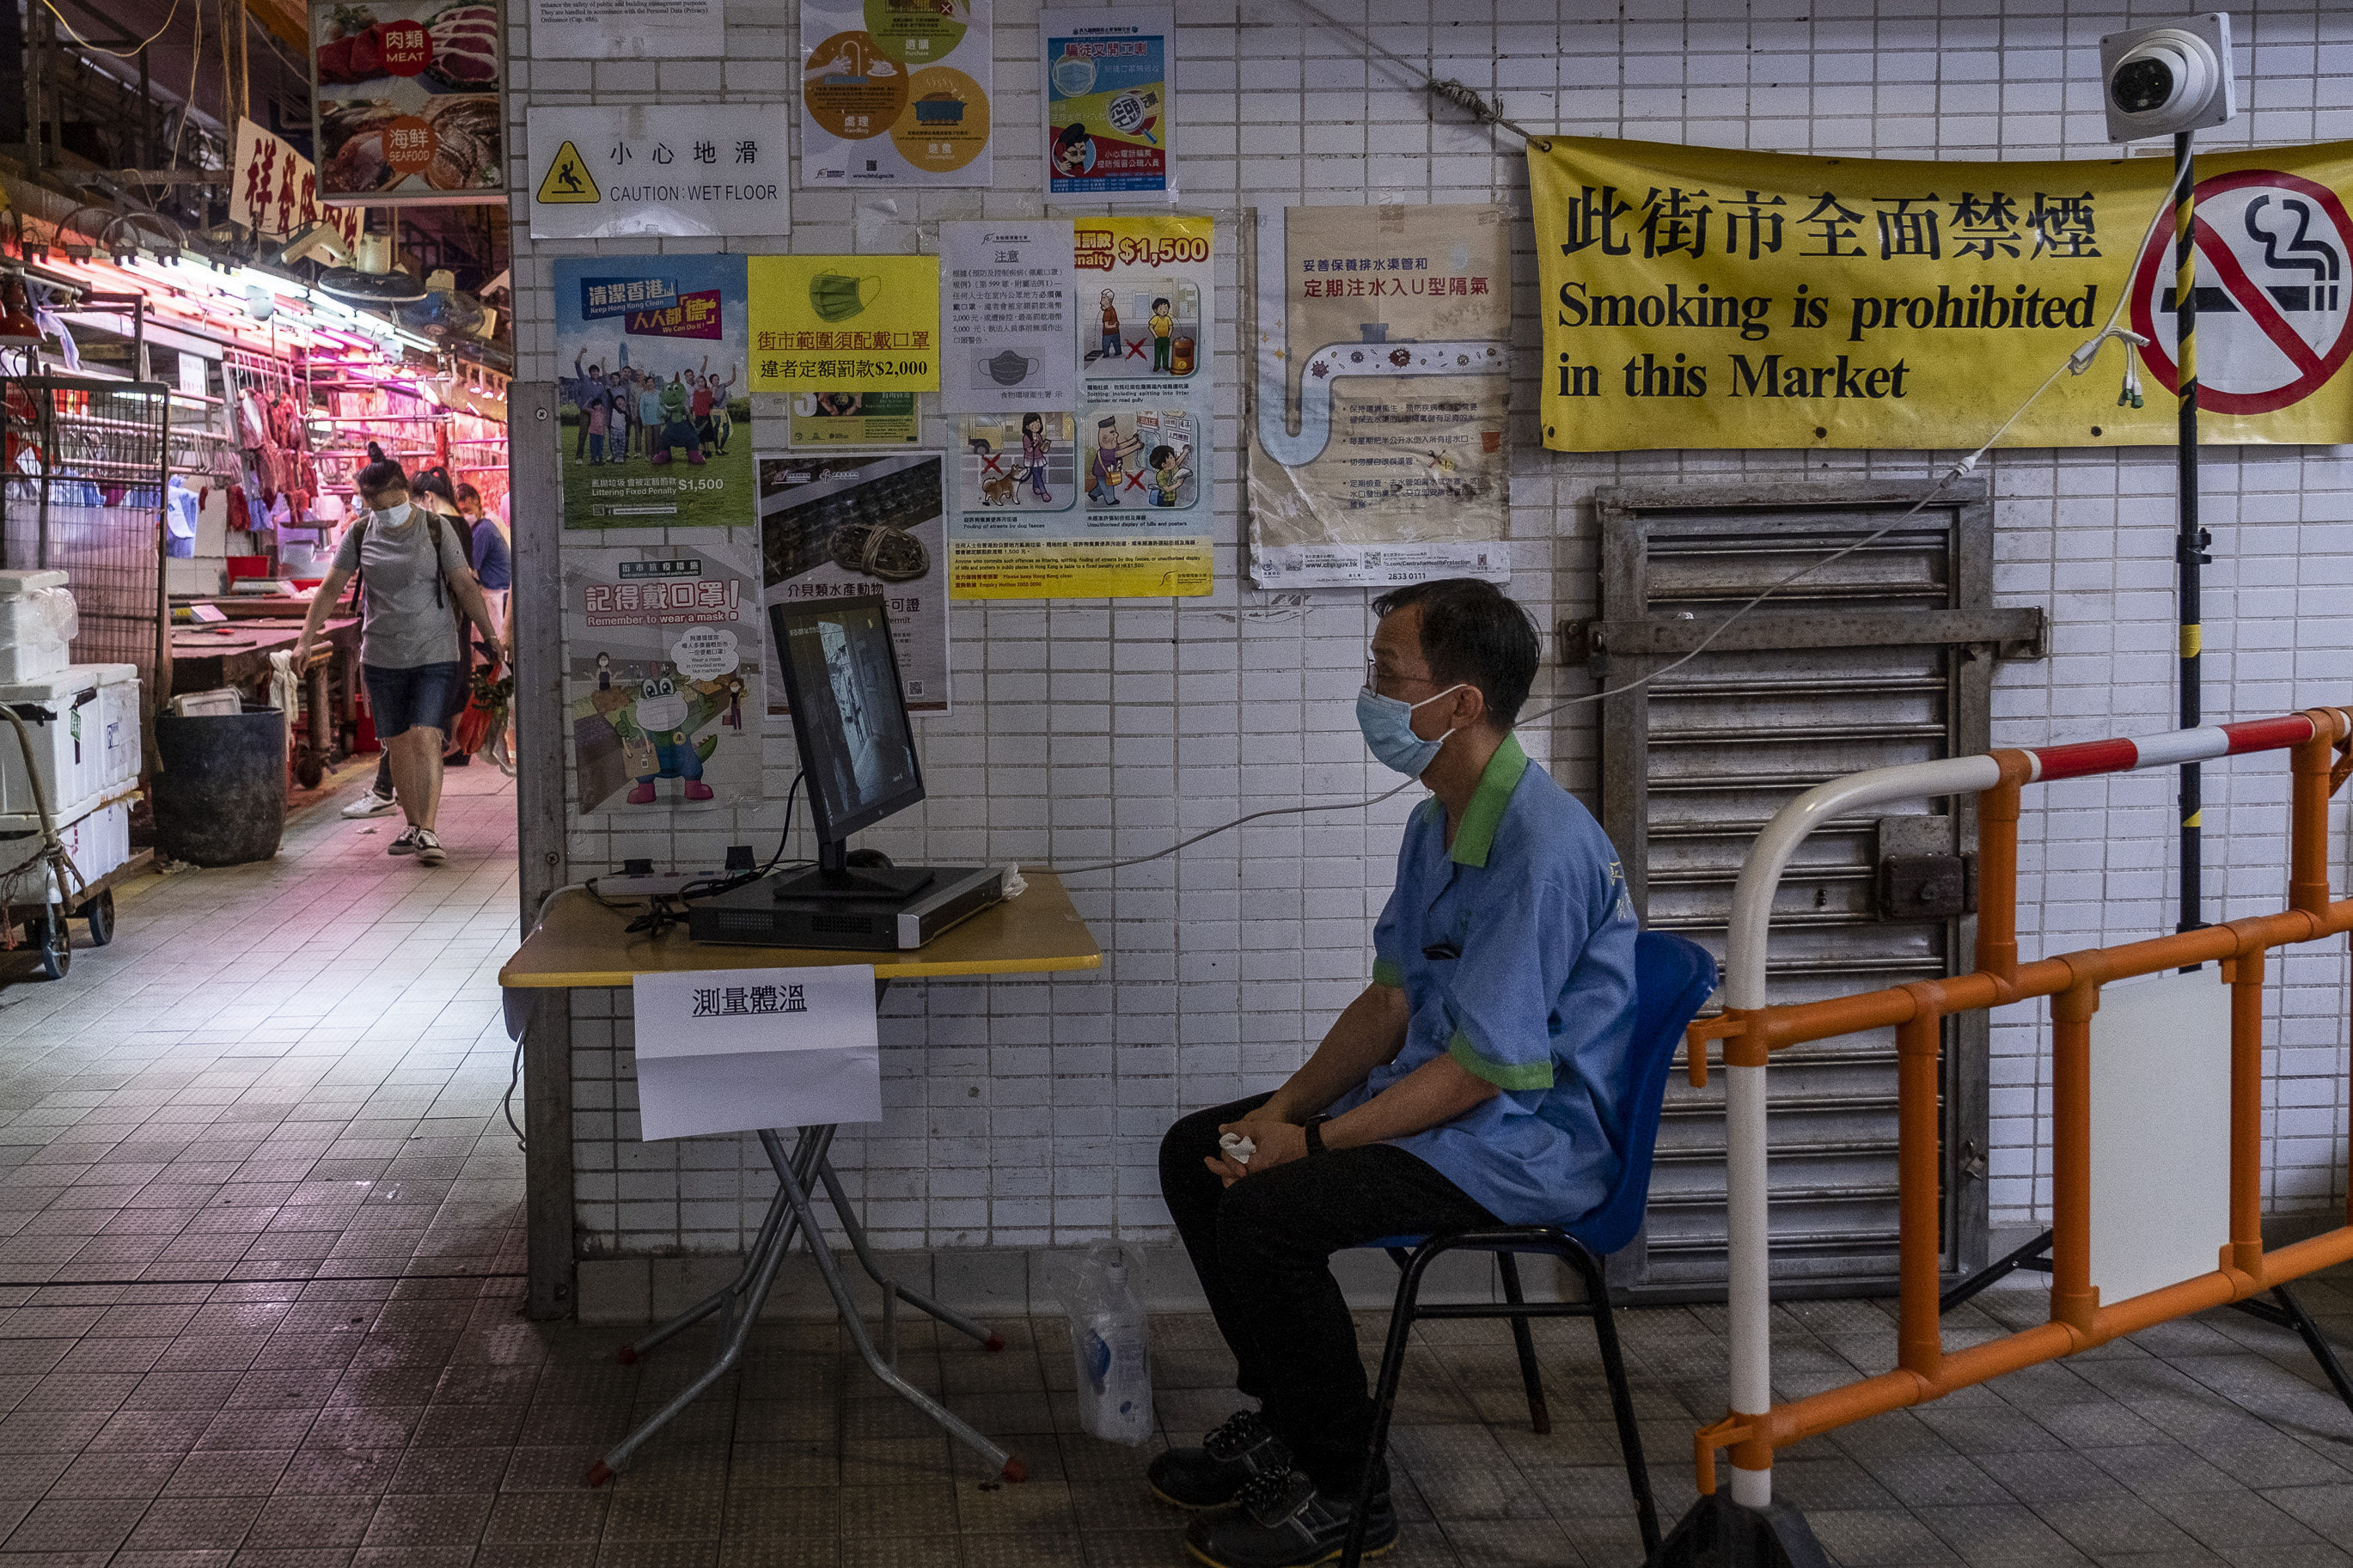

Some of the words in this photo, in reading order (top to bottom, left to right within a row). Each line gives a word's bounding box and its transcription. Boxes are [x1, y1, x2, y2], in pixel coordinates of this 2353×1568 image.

[387, 30, 423, 48] 肉類
[387, 52, 425, 62] MEAT
[389, 128, 429, 149] 海鮮
[389, 149, 430, 162] SEAFOOD
[610, 140, 758, 165] 小心地滑
[725, 184, 778, 200] FLOOR
[1560, 186, 2103, 261] 此街市全面禁煙
[994, 250, 1019, 263] 注意
[1119, 237, 1208, 267] $1,500
[1303, 258, 1428, 272] 妥善保養排水渠管和
[590, 278, 663, 306] 清潔香港
[1303, 277, 1488, 298] 定期注水入U型隔氣
[590, 306, 608, 314] Keep
[608, 303, 626, 313] Hong
[626, 302, 645, 312] Kong
[645, 299, 663, 308] Clean
[1558, 282, 1772, 340] Smoking
[1791, 284, 1829, 329] is
[1849, 284, 2099, 341] prohibited
[686, 323, 696, 332] Do
[757, 332, 930, 351] 街市範圍須配戴口罩
[1557, 352, 1599, 397] in
[1623, 352, 1708, 398] this
[1727, 354, 1910, 400] Market
[591, 488, 625, 497] Littering
[626, 486, 647, 496] Fixed
[648, 486, 677, 497] Penalty
[677, 479, 724, 493] $1,500
[622, 561, 699, 572] 街市抗疫措施
[787, 583, 883, 598] 介貝類水產動物
[885, 598, 920, 613] 可證
[586, 615, 643, 625] Remember
[645, 613, 657, 624] to
[660, 613, 685, 623] wear
[688, 613, 694, 622] a
[696, 612, 725, 621] mask
[692, 985, 808, 1017] 測量體溫
